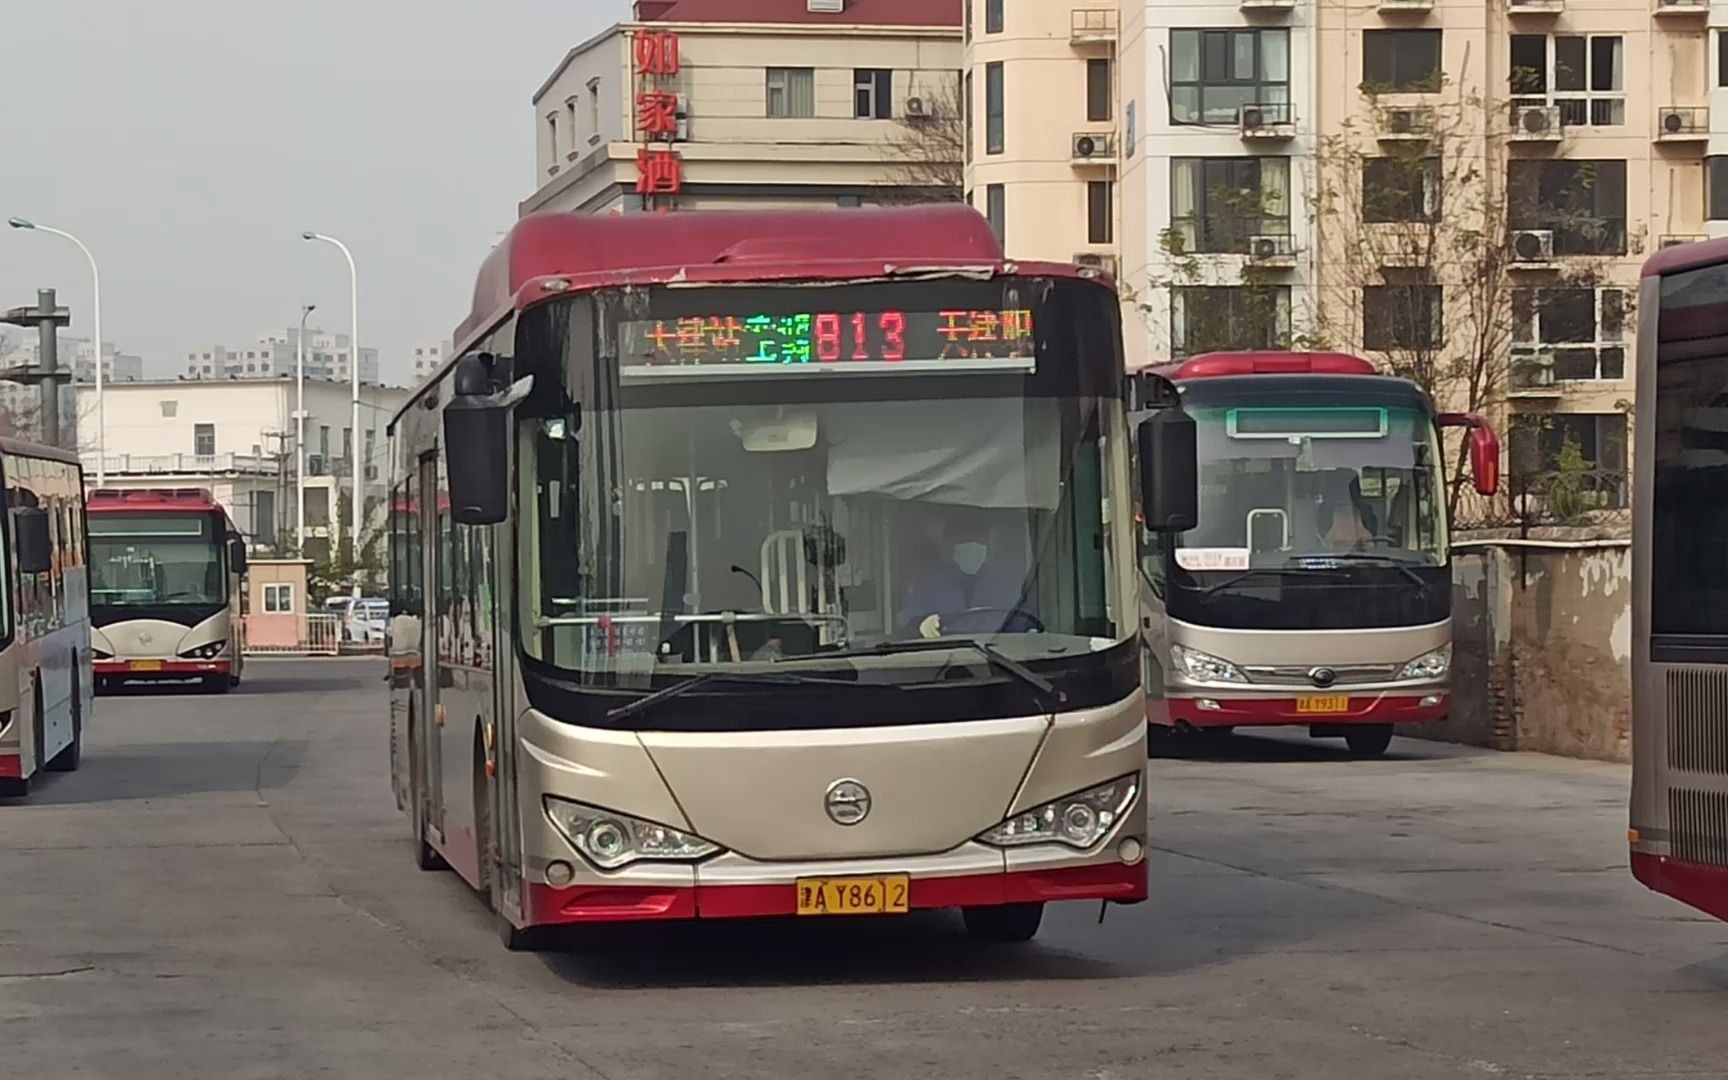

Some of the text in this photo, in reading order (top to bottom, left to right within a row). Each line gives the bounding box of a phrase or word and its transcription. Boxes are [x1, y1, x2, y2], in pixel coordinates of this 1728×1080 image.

[635, 28, 681, 212] 如家酒
[814, 310, 906, 361] 813
